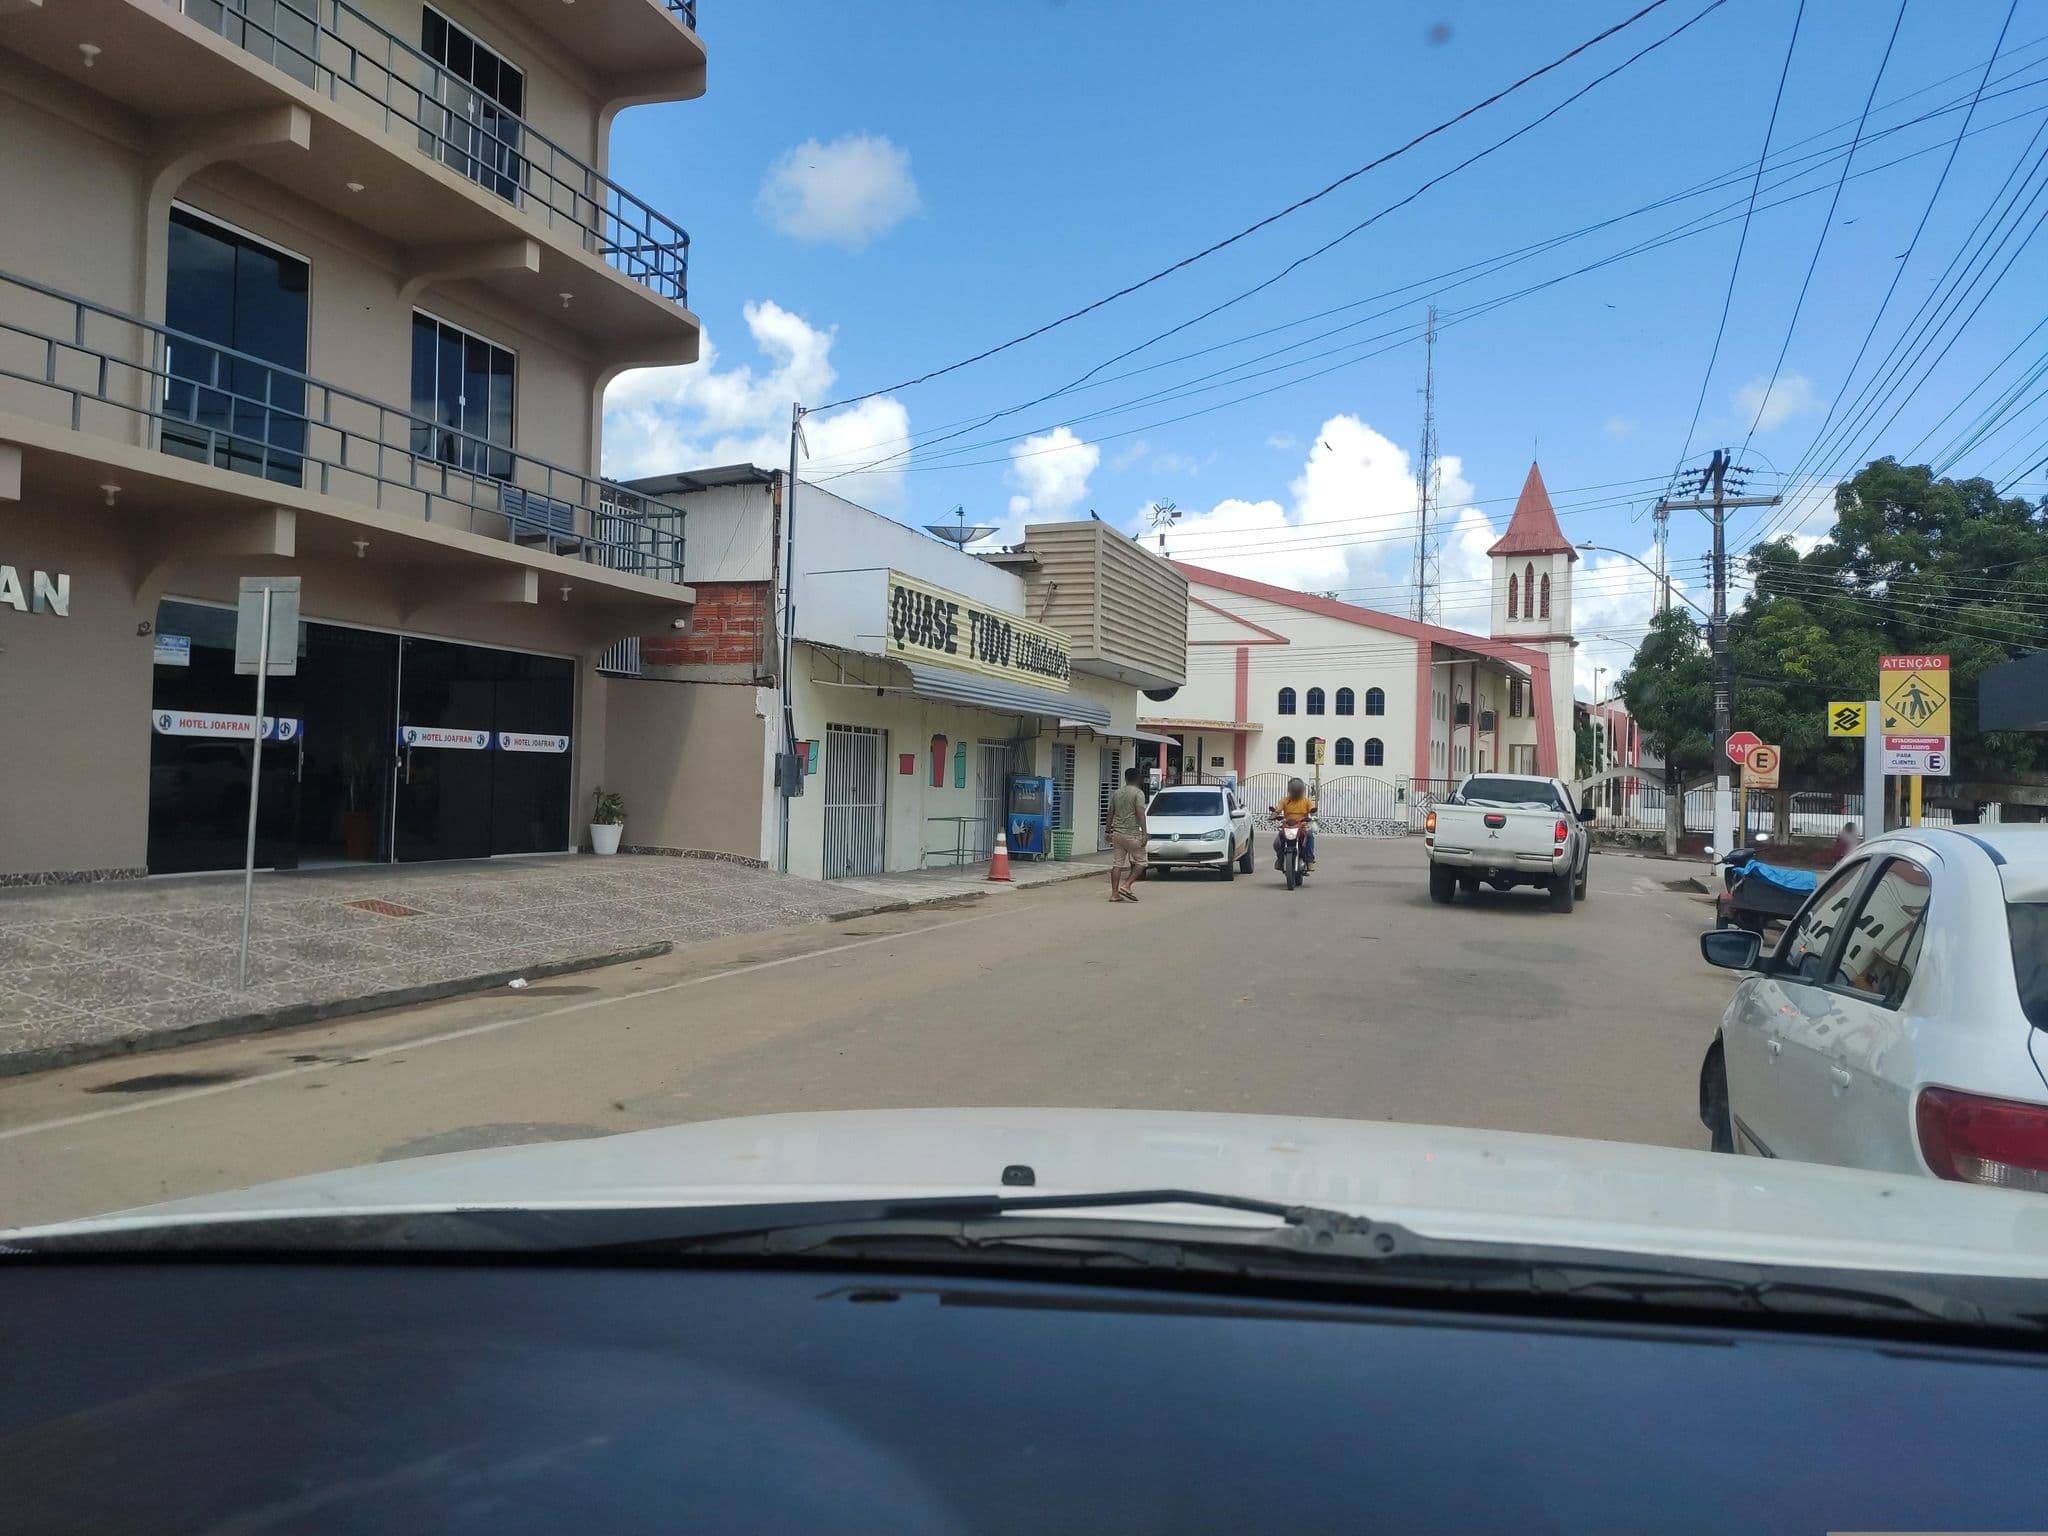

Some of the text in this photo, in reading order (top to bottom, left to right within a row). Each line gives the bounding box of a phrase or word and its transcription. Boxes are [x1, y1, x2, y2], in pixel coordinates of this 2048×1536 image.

[0, 565, 70, 617] AN
[891, 585, 959, 654] QUASE
[968, 609, 1012, 667] TUDO
[1883, 656, 1942, 670] ATENÇÃO
[179, 719, 208, 729] HOTEL
[210, 720, 250, 731] JOAFRAN
[421, 733, 443, 742] HOTEL
[444, 735, 473, 744] JOAFRAN
[513, 738, 531, 747] HOTEL
[1756, 753, 1768, 768] E
[1929, 755, 1941, 769] E
